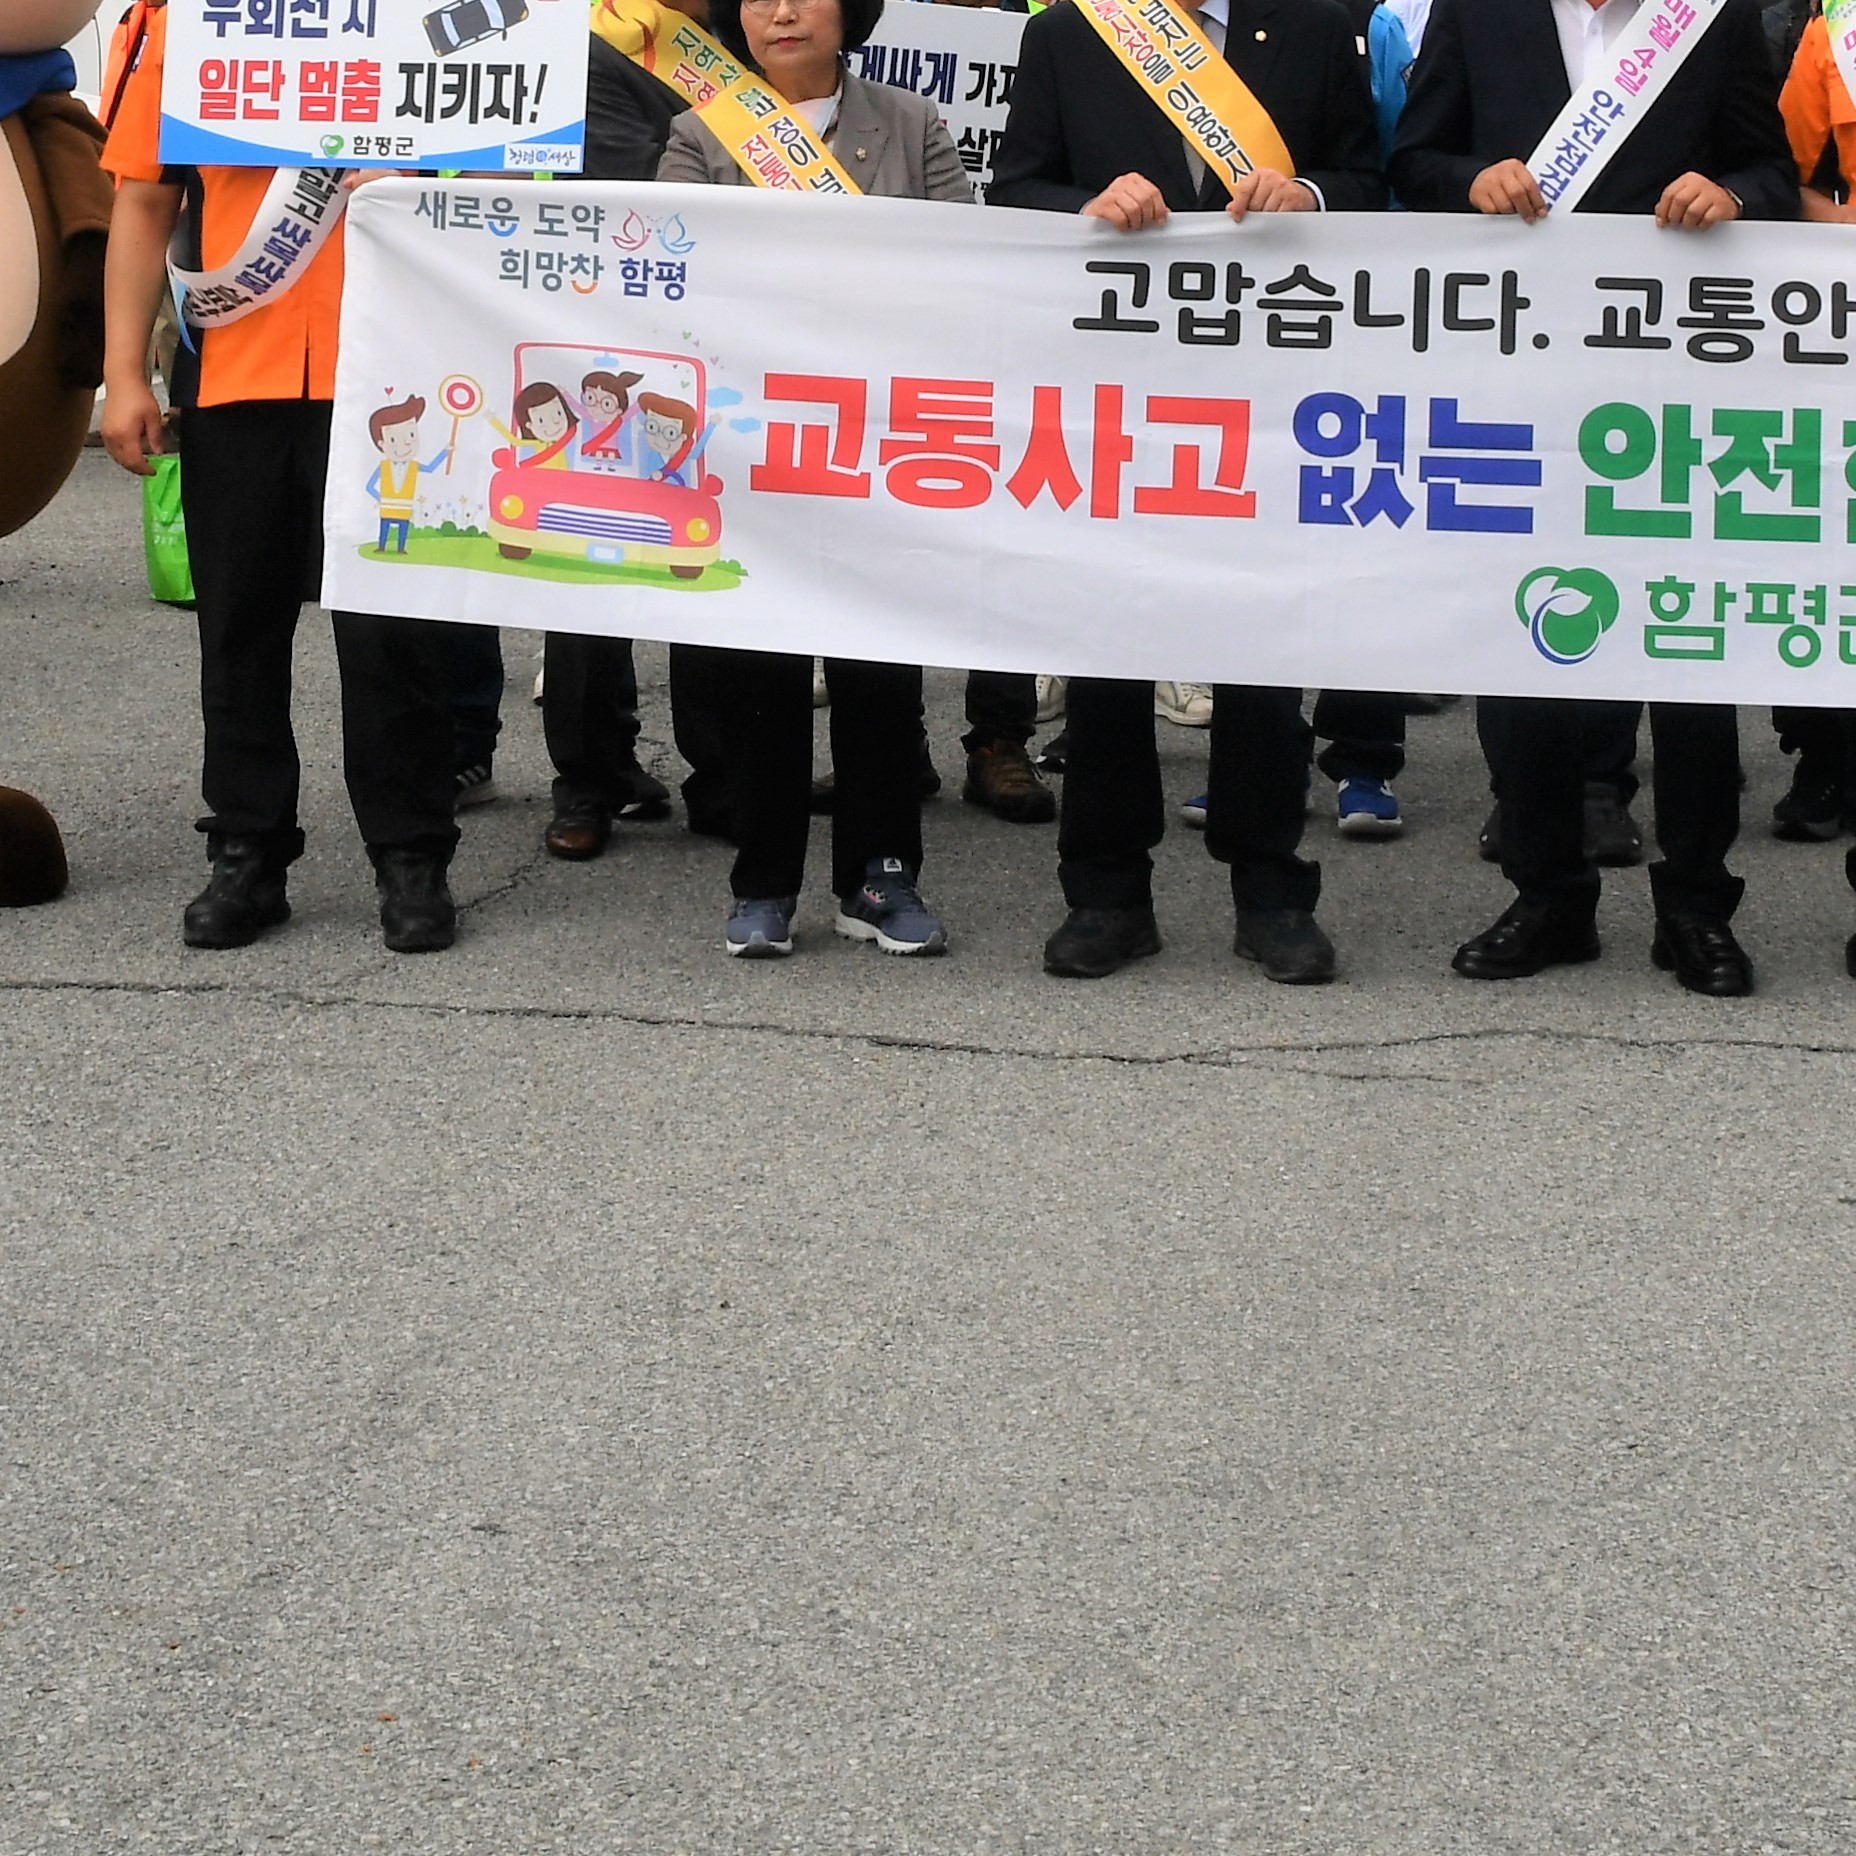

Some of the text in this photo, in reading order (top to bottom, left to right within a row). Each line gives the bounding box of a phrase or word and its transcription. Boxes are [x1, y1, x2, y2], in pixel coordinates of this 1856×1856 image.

[198, 58, 548, 125] 일단 멈춤 지키자!
[846, 44, 959, 107] 게싸게
[1614, 47, 1657, 97] 4일
[352, 135, 414, 156] 함평군
[767, 116, 820, 167] 정이
[1537, 89, 1626, 212] 안전점검
[413, 189, 606, 244] 새로운 도약
[499, 247, 687, 302] 희망찬 함평
[1072, 260, 1550, 355] 고맙습니다.
[749, 372, 1257, 520] 교통사고
[1292, 391, 1543, 535] 없는
